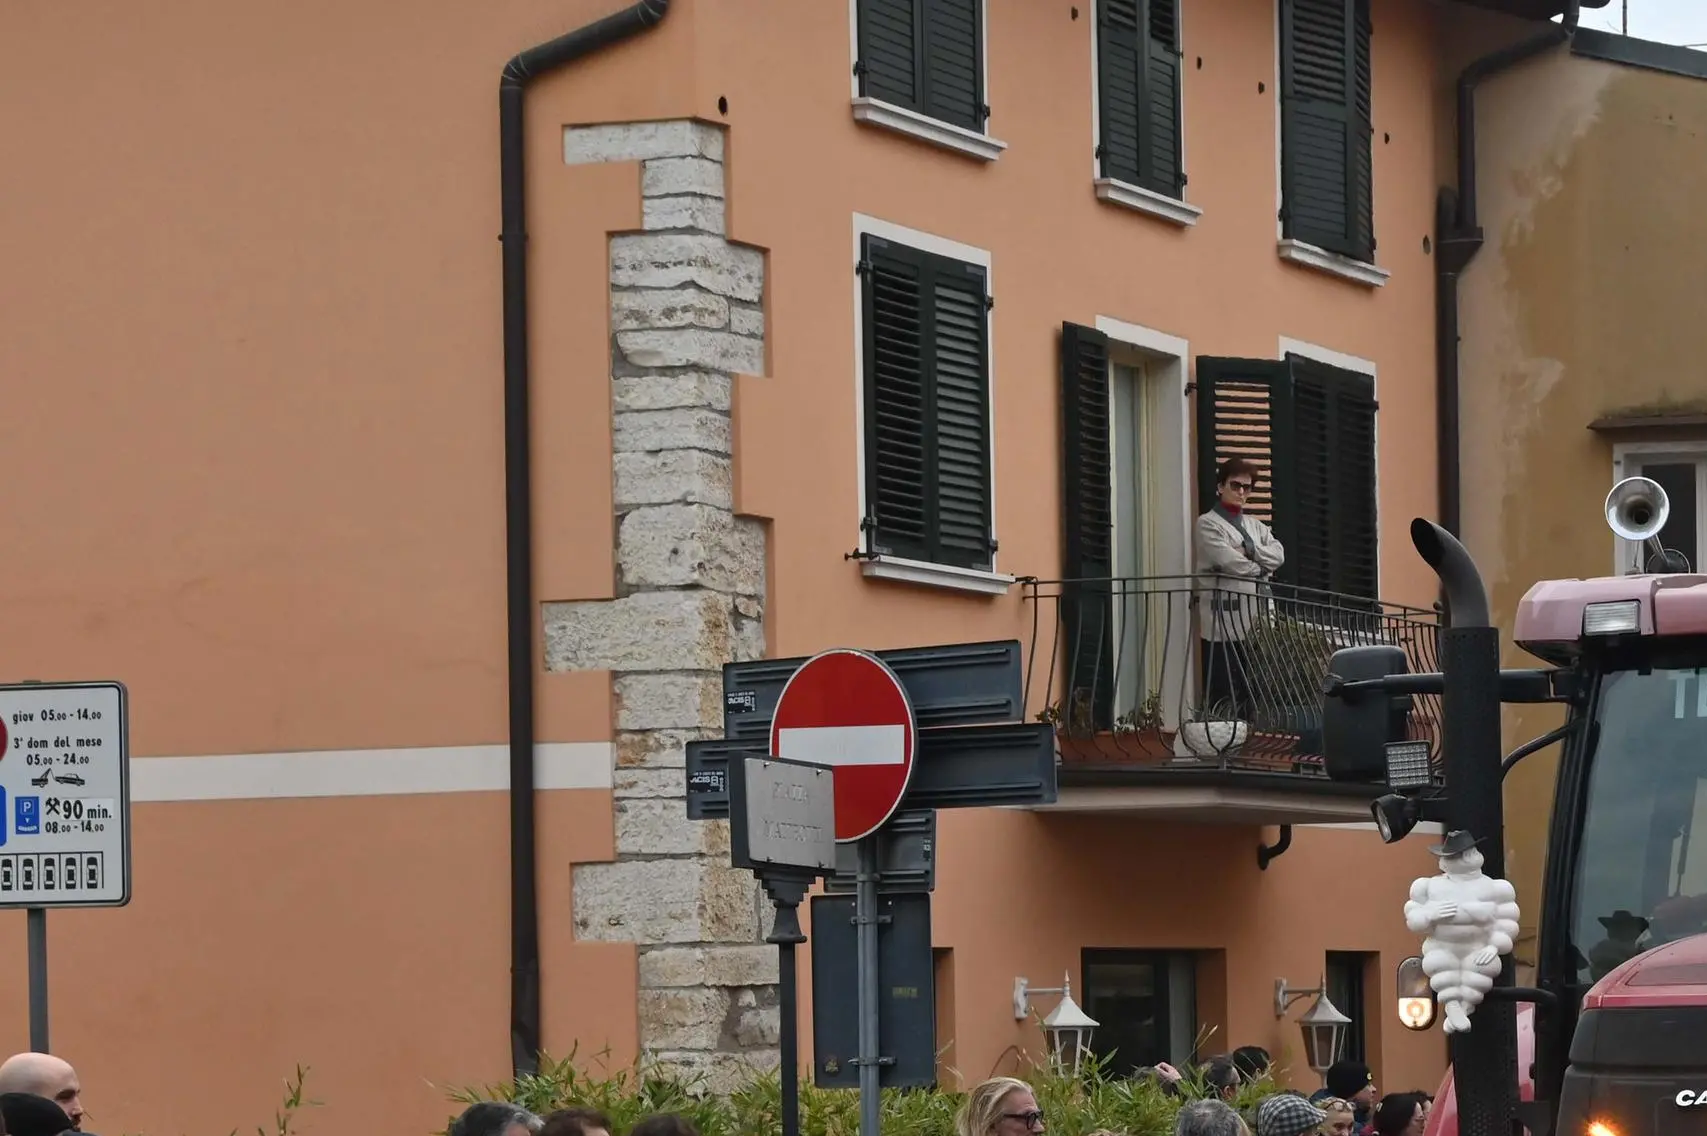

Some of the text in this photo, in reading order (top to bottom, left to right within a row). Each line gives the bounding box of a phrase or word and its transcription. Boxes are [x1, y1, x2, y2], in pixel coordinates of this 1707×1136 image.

[13, 710, 34, 725] giov
[41, 708, 67, 721] 05.00
[77, 708, 102, 721] 14.00
[27, 736, 48, 749] dom
[54, 735, 71, 748] del
[76, 738, 102, 748] mese
[26, 754, 53, 766] 05.00
[63, 752, 90, 765] 24.00
[23, 801, 32, 813] P
[62, 799, 112, 820] 90 min.
[45, 821, 71, 834] 08.00
[80, 820, 104, 833] 14.00
